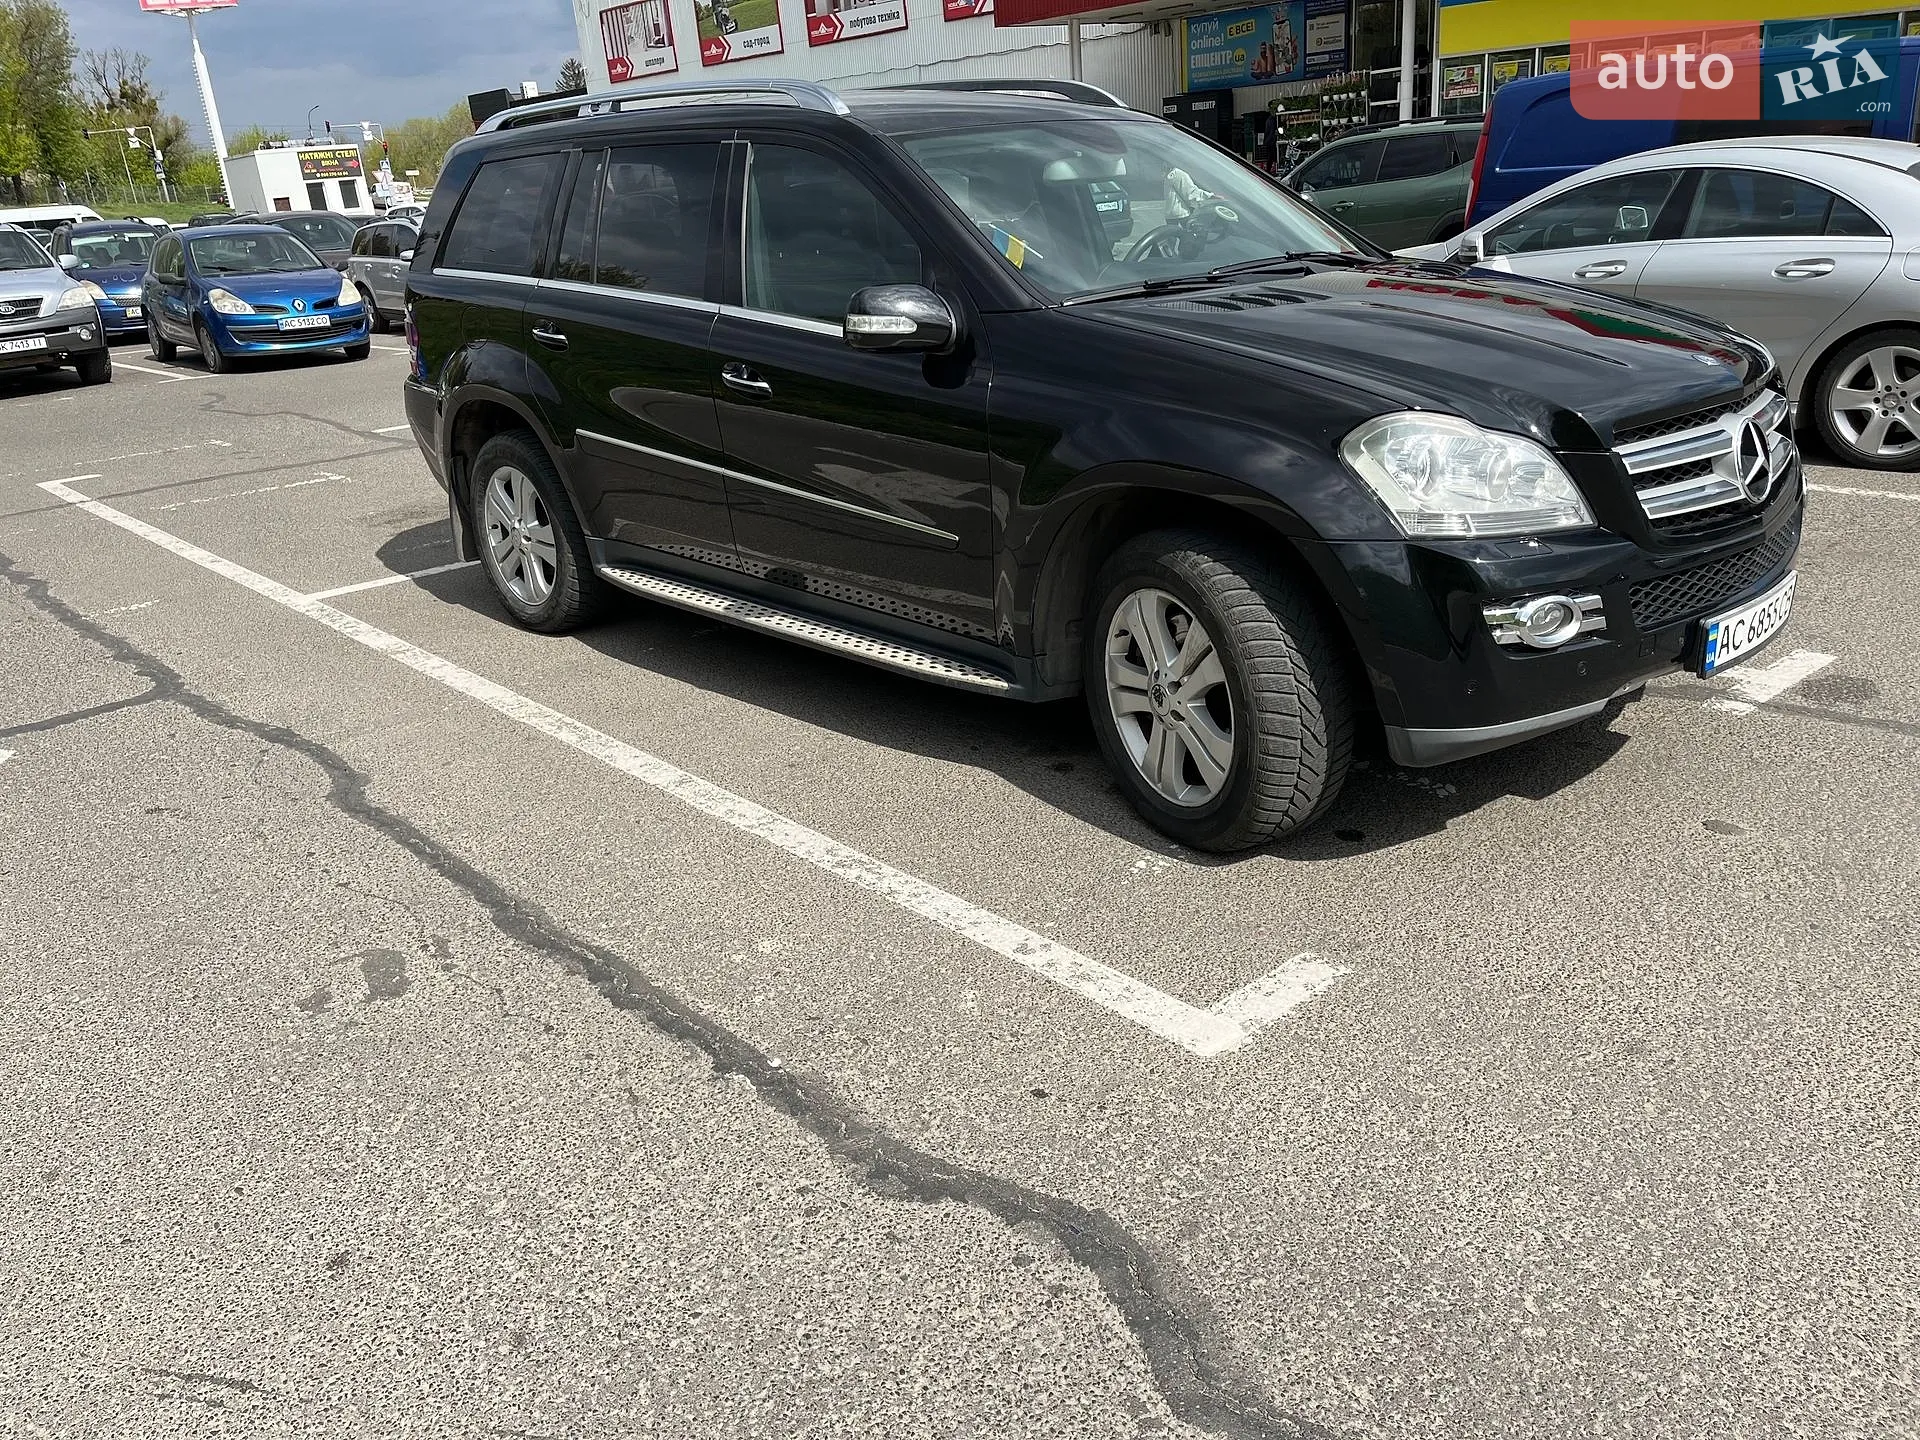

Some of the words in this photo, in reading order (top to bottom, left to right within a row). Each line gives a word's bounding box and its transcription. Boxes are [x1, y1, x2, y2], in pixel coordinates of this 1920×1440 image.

[849, 15, 876, 29] побутова
[877, 9, 900, 23] техніка
[1235, 21, 1254, 35] ВСЕ!
[742, 36, 771, 49] сад-город
[1190, 32, 1224, 50] online!
[299, 151, 333, 160] НАТЯЖНІ
[336, 150, 357, 158] СТЕЛІ
[284, 319, 296, 328] AC
[297, 317, 315, 327] 5132
[316, 316, 328, 325] CO
[0, 342, 8, 351] K
[9, 340, 29, 350] 7413
[1718, 618, 1745, 659] AC
[1747, 596, 1780, 644] 6855
